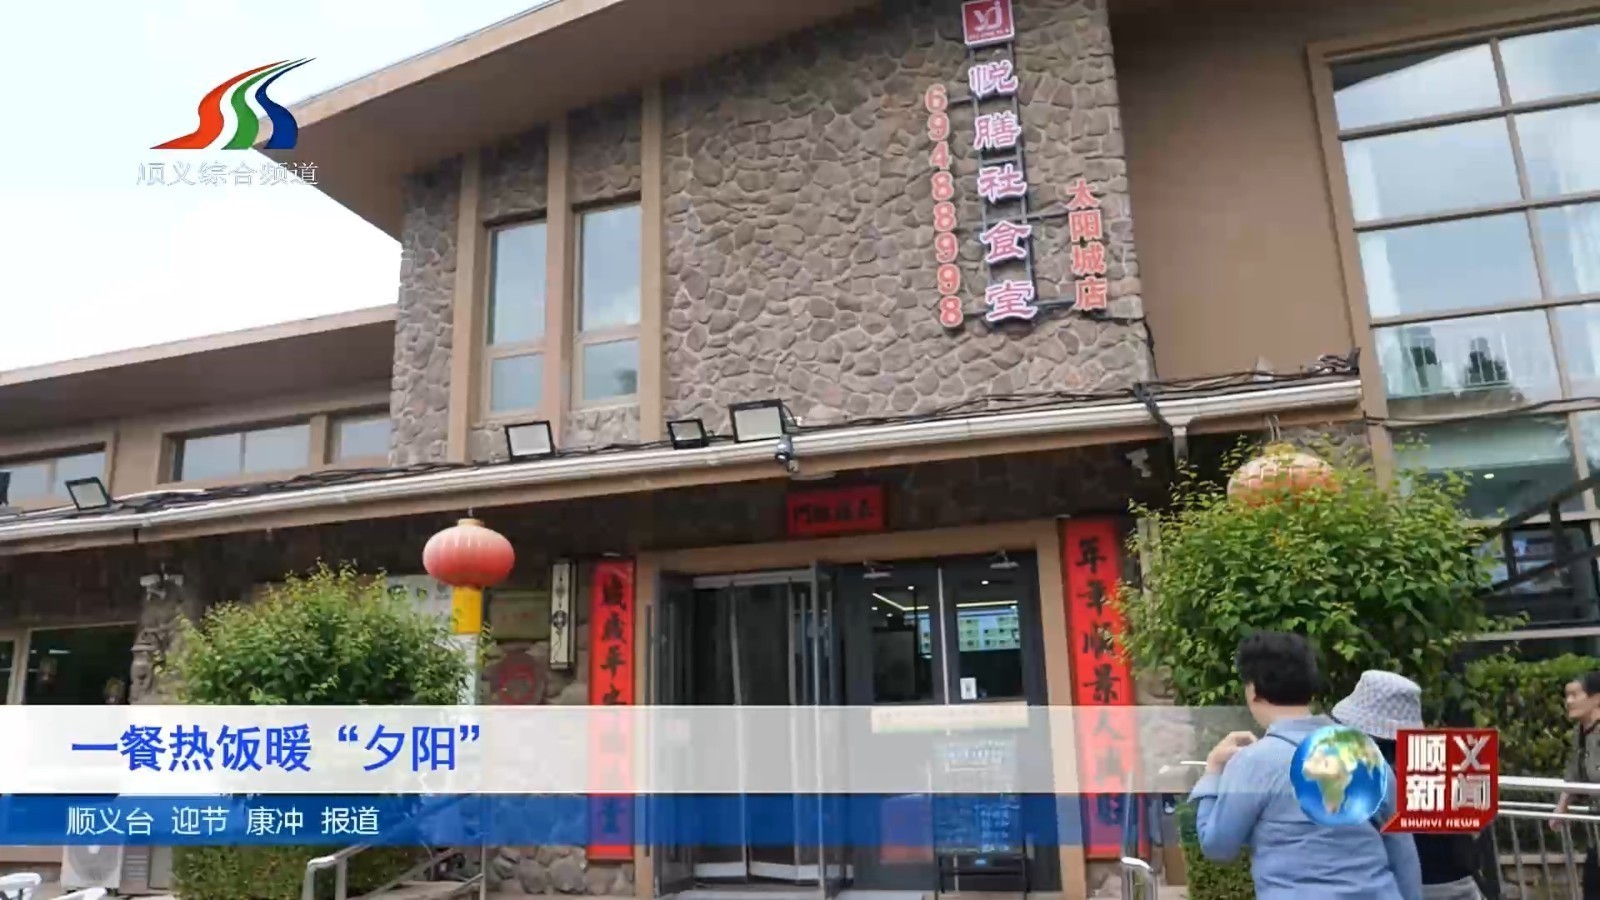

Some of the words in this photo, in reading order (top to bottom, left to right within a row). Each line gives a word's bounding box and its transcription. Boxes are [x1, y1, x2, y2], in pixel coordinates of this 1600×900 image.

[924, 84, 964, 328] 69488998
[969, 60, 1037, 323] 悦膳社食堂
[1066, 180, 1108, 312] 太阳城店
